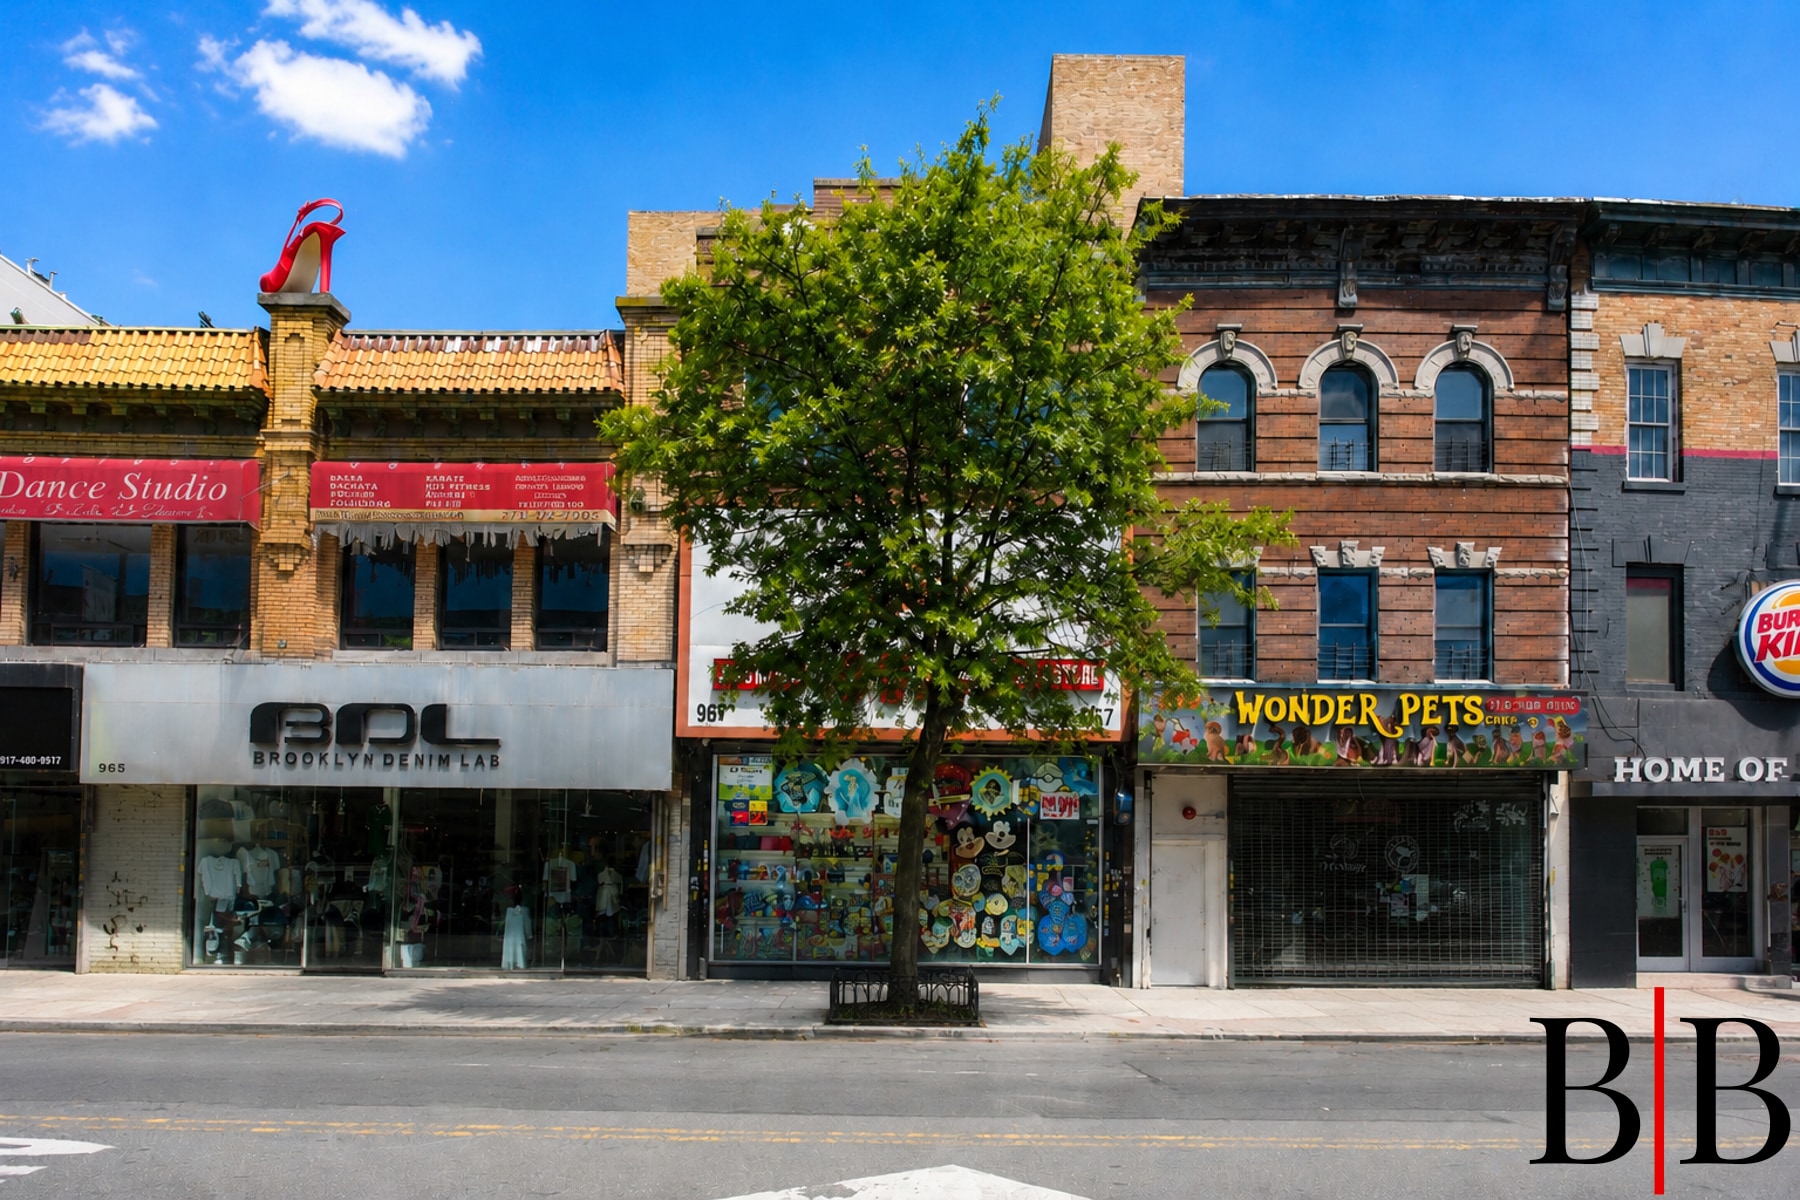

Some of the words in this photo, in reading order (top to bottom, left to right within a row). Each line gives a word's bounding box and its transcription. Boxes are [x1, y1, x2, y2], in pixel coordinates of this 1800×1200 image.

[0, 470, 106, 500] Dance
[117, 471, 228, 502] Studio
[1235, 691, 1403, 738] WONDER
[1400, 693, 1485, 726] PETS
[98, 763, 125, 773] 965
[253, 751, 374, 767] BROOKLYN
[383, 753, 450, 768] DENIM
[461, 754, 500, 768] LAB
[1614, 756, 1726, 783] HOME
[1738, 756, 1788, 783] OF
